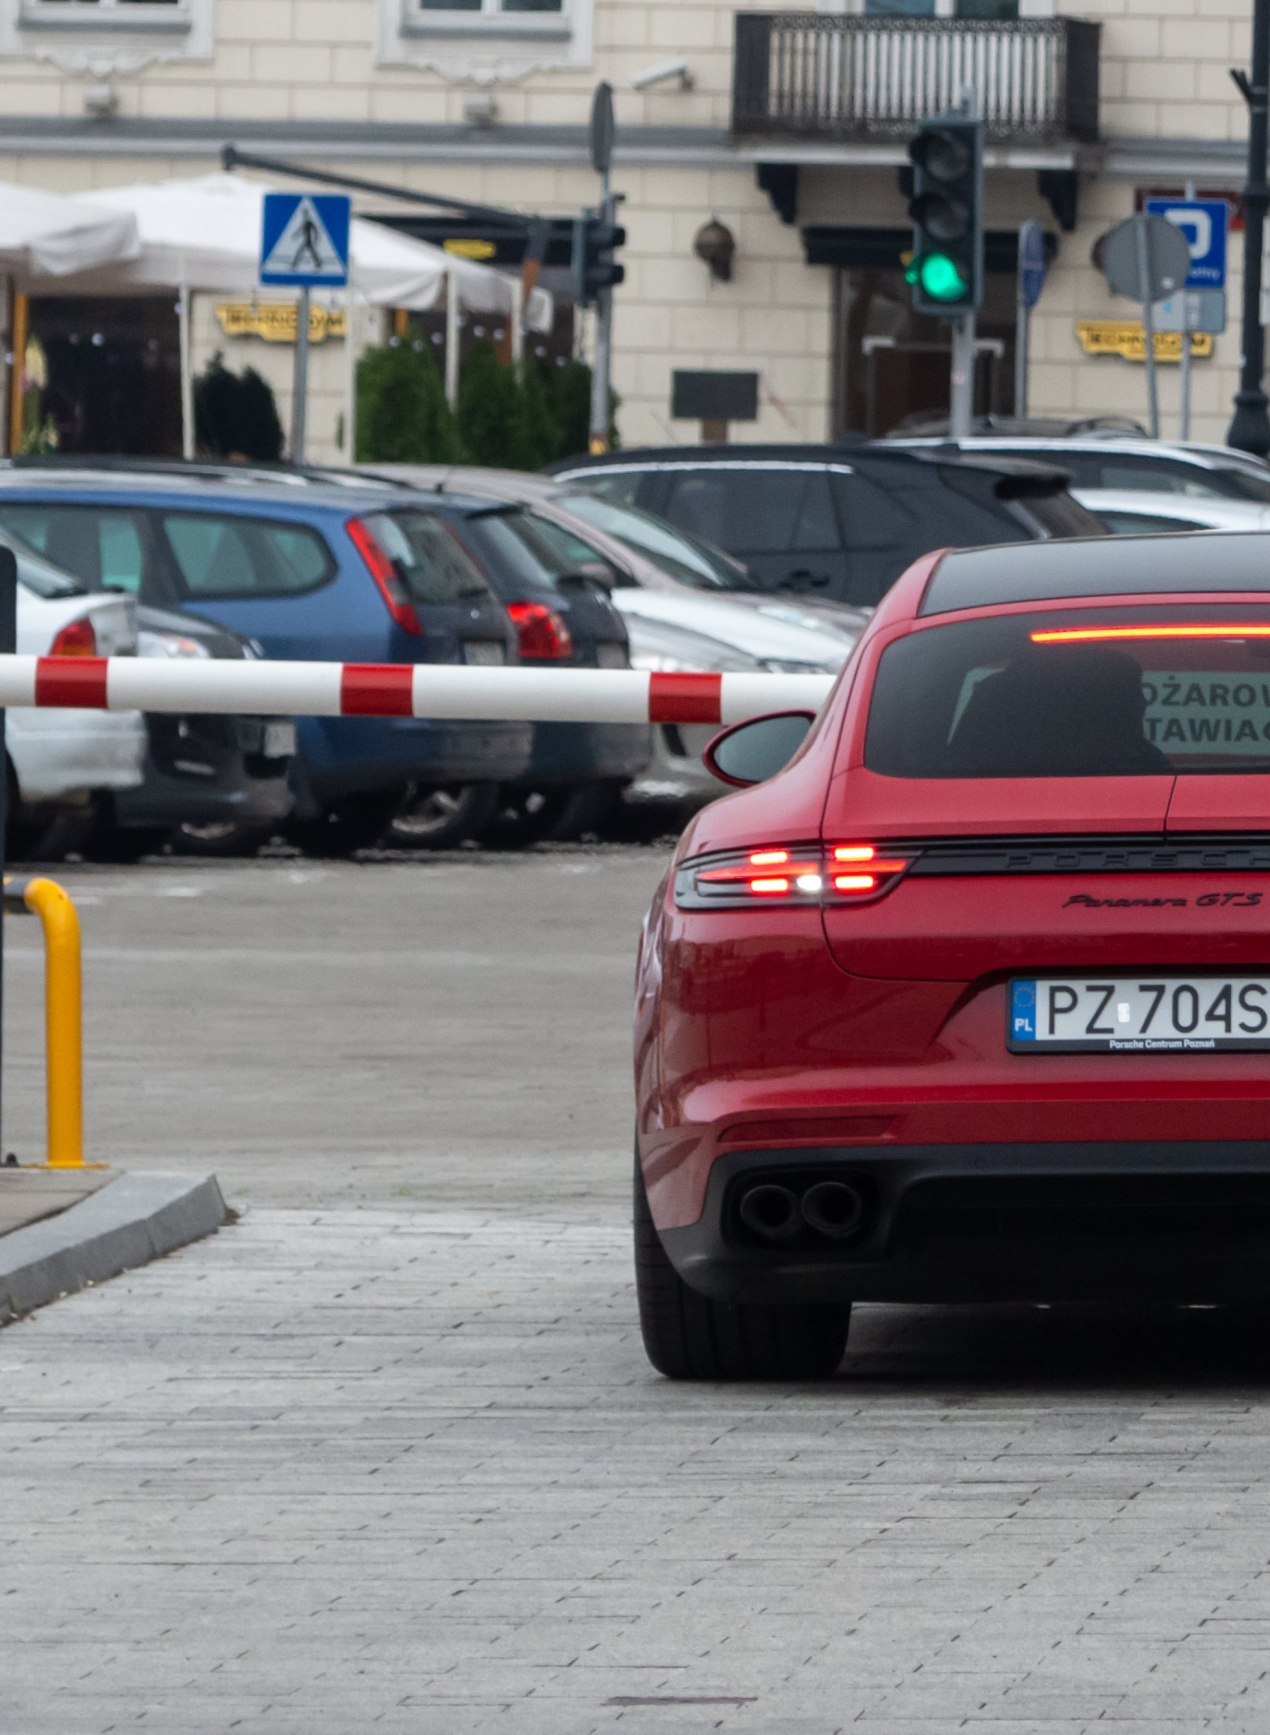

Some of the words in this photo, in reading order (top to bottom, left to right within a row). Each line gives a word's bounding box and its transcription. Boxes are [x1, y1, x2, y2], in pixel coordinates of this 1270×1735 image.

[1062, 894, 1188, 909] Panamera
[1195, 892, 1264, 907] GTS
[1049, 984, 1116, 1035] PZ
[1014, 1018, 1033, 1032] PL
[1109, 1039, 1143, 1050] Porsche
[1145, 1038, 1182, 1049] Centrum
[1184, 1038, 1215, 1048] Poznań
